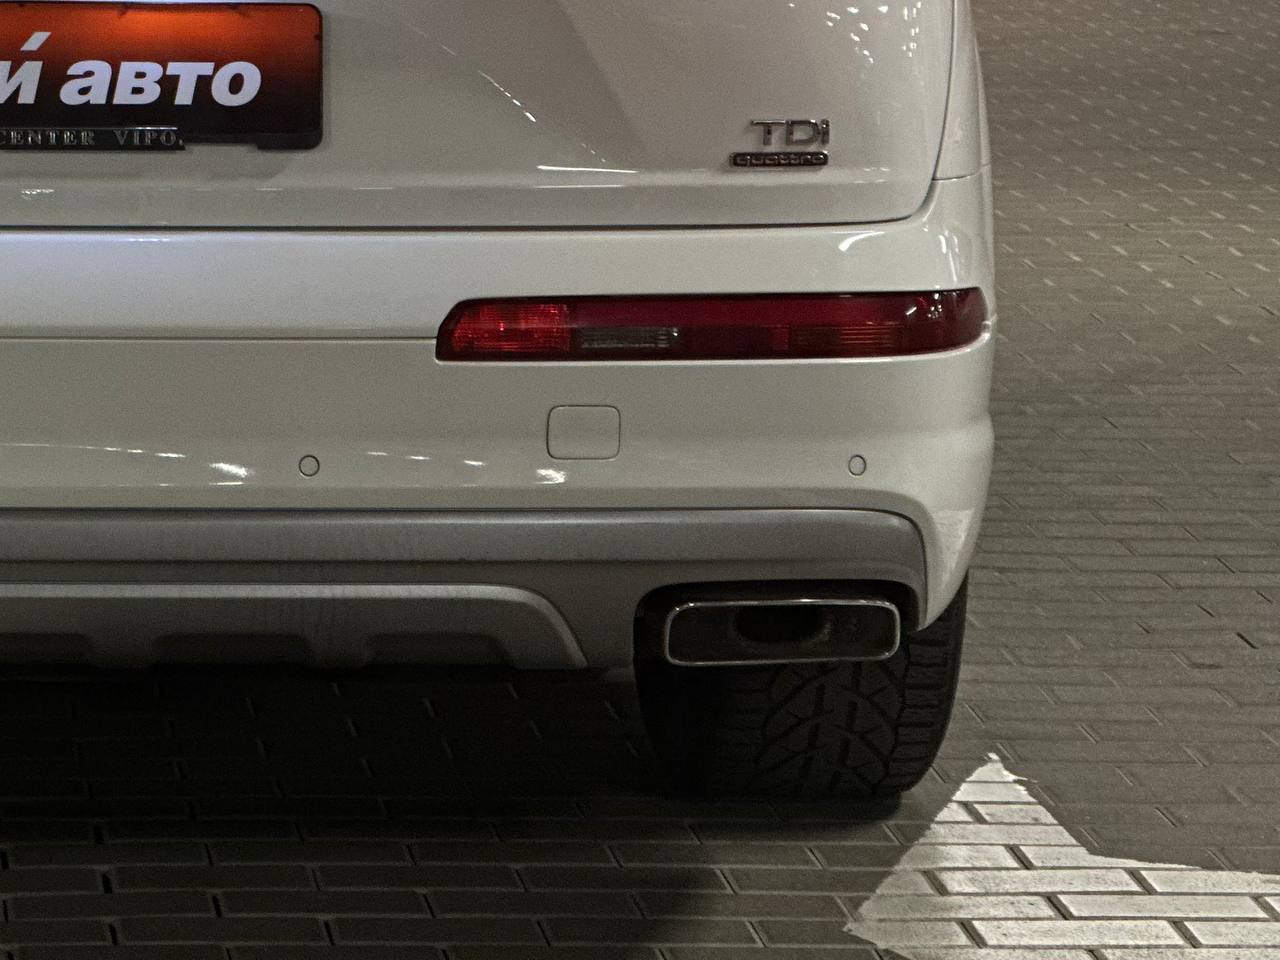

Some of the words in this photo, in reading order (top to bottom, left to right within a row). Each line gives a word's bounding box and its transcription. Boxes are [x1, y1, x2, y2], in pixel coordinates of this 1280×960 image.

[59, 61, 262, 106] авто
[113, 129, 183, 146] VIPO
[751, 120, 829, 146] TDI
